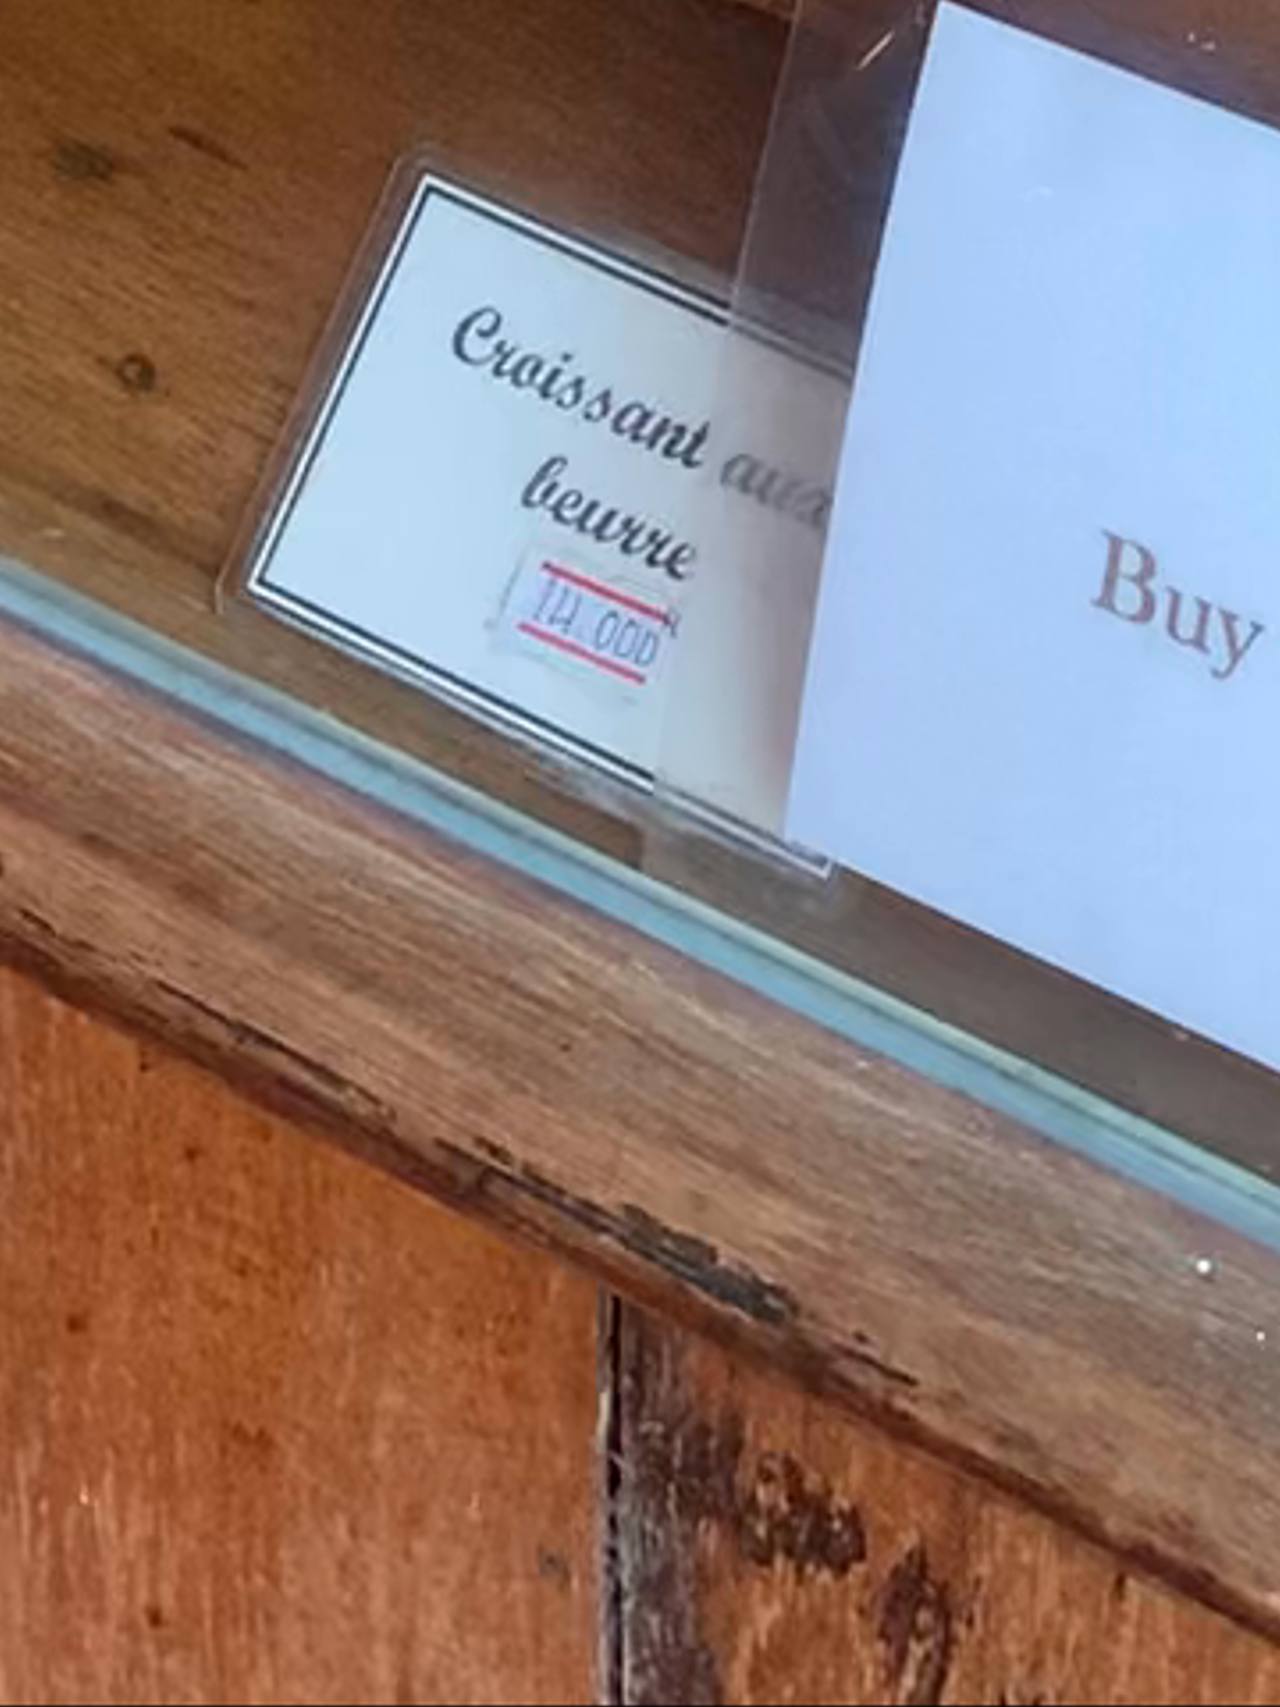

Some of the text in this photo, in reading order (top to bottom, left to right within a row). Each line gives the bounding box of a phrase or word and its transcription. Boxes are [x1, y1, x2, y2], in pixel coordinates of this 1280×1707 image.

[452, 307, 710, 469] Croissant
[521, 457, 697, 582] beurre
[1091, 530, 1265, 680] Buy
